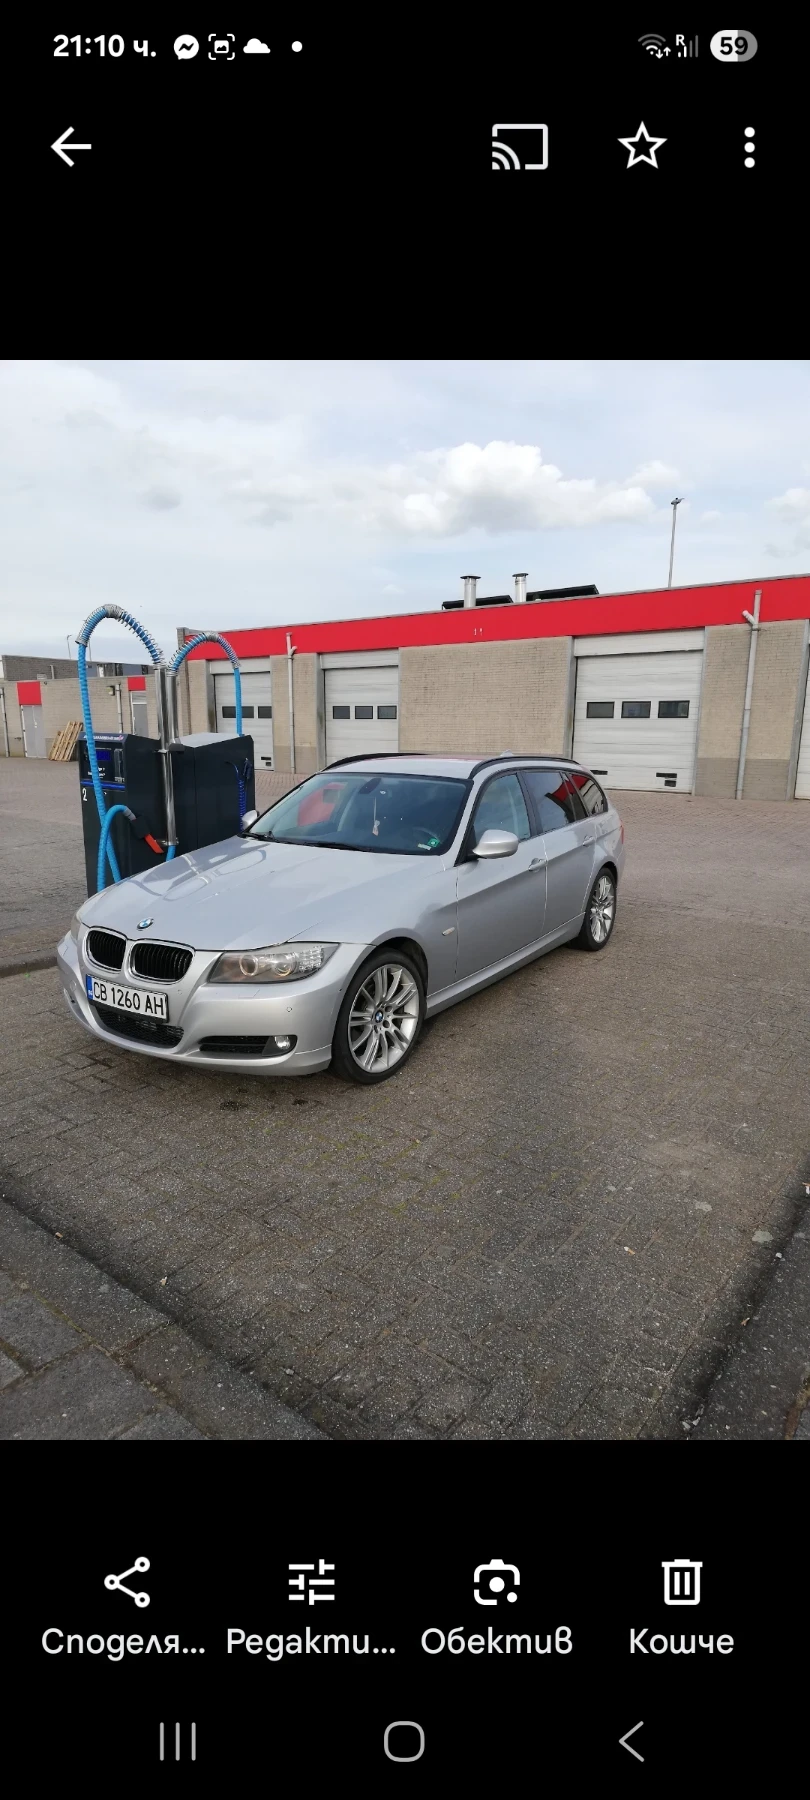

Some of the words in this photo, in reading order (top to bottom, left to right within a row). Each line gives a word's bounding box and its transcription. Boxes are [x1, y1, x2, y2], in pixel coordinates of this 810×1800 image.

[82, 787, 88, 802] 2
[93, 981, 107, 1001] CB
[111, 988, 140, 1010] 1260
[145, 995, 164, 1015] AH
